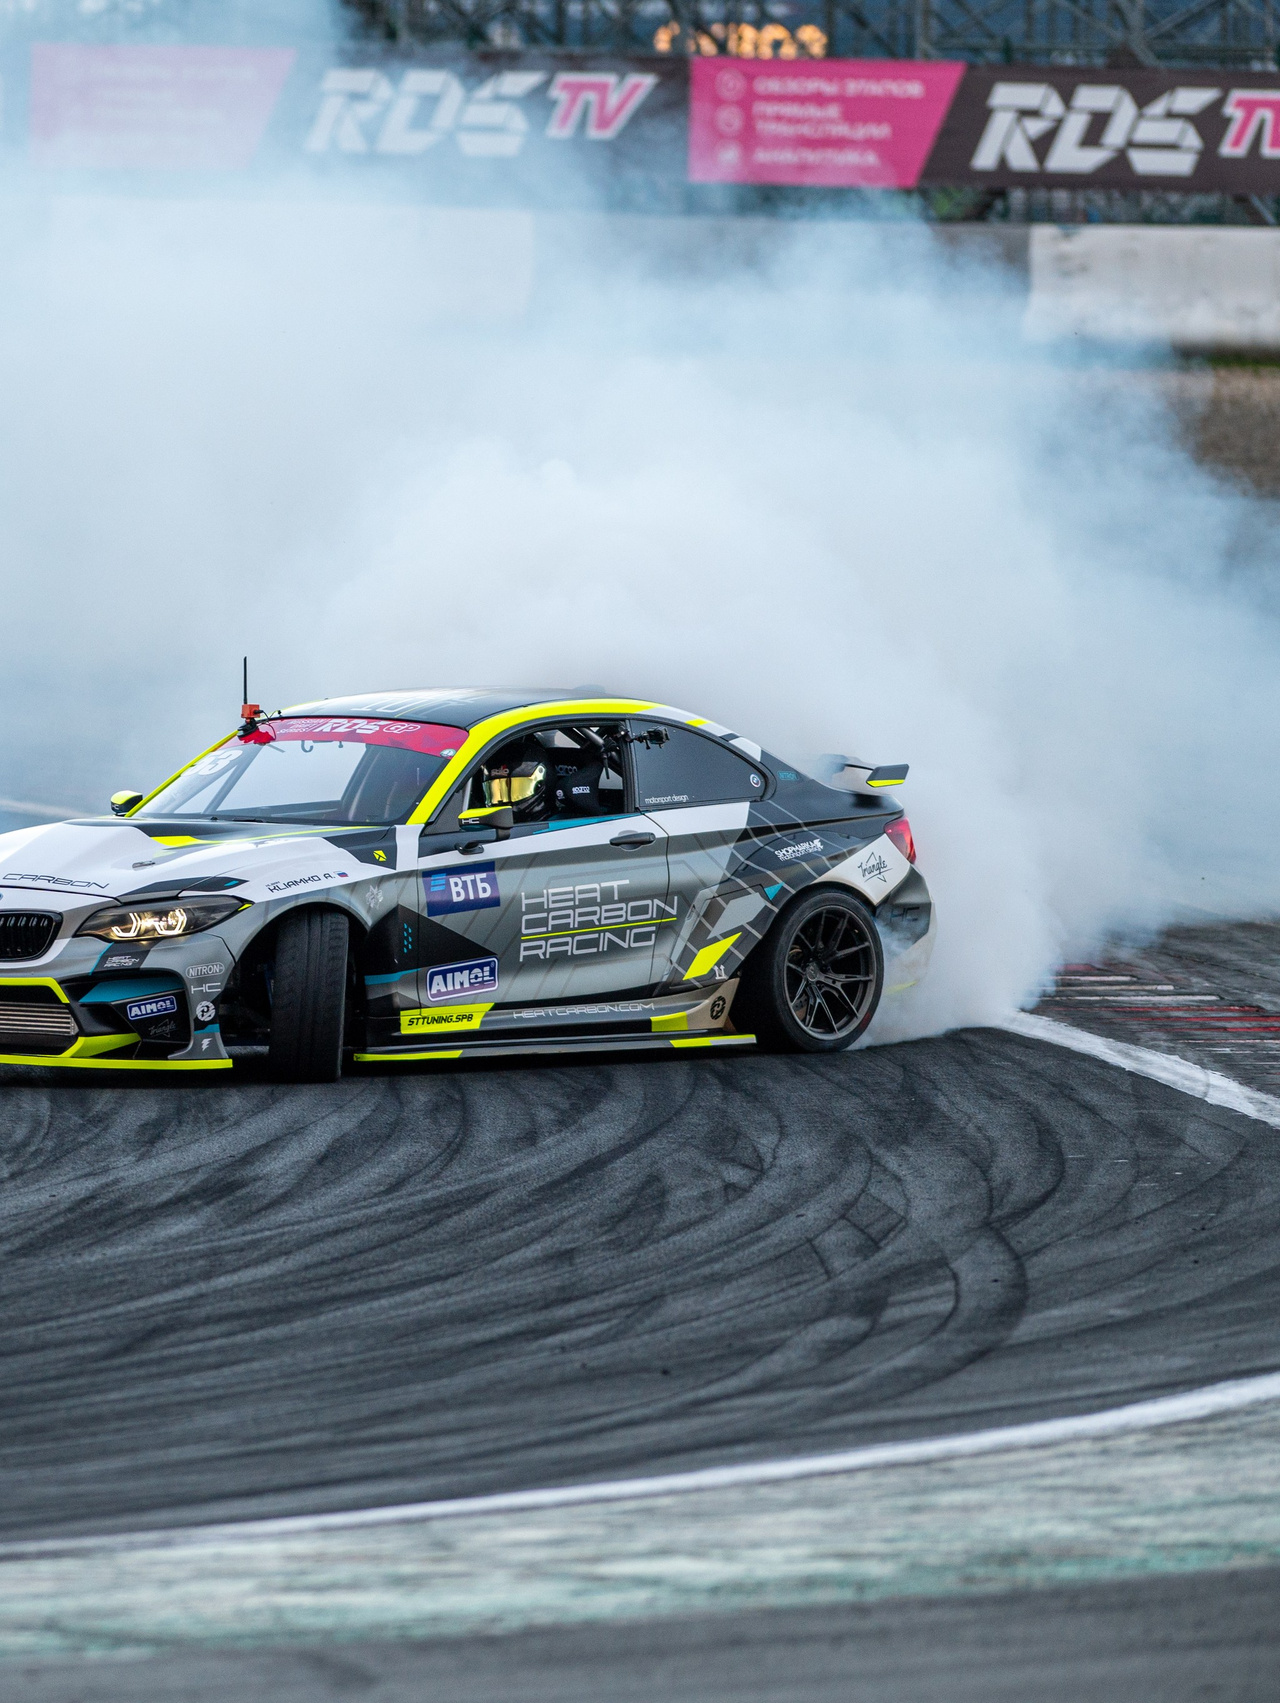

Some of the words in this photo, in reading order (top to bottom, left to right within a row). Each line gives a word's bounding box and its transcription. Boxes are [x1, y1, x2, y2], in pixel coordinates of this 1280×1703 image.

[303, 68, 549, 158] RDS
[544, 72, 660, 141] TV
[970, 81, 1222, 177] RDS
[314, 719, 394, 734] RDS
[2, 873, 110, 890] CARBON
[449, 872, 492, 903] ВТБ
[521, 879, 630, 912] HEAT
[521, 896, 678, 935] CARBON
[519, 926, 656, 962] RACING
[189, 965, 220, 977] NITRON
[431, 966, 495, 995] AIMOL
[191, 982, 221, 994] HC
[130, 1001, 174, 1017] AIMOL
[513, 1003, 655, 1019] HEATCARBON.COM
